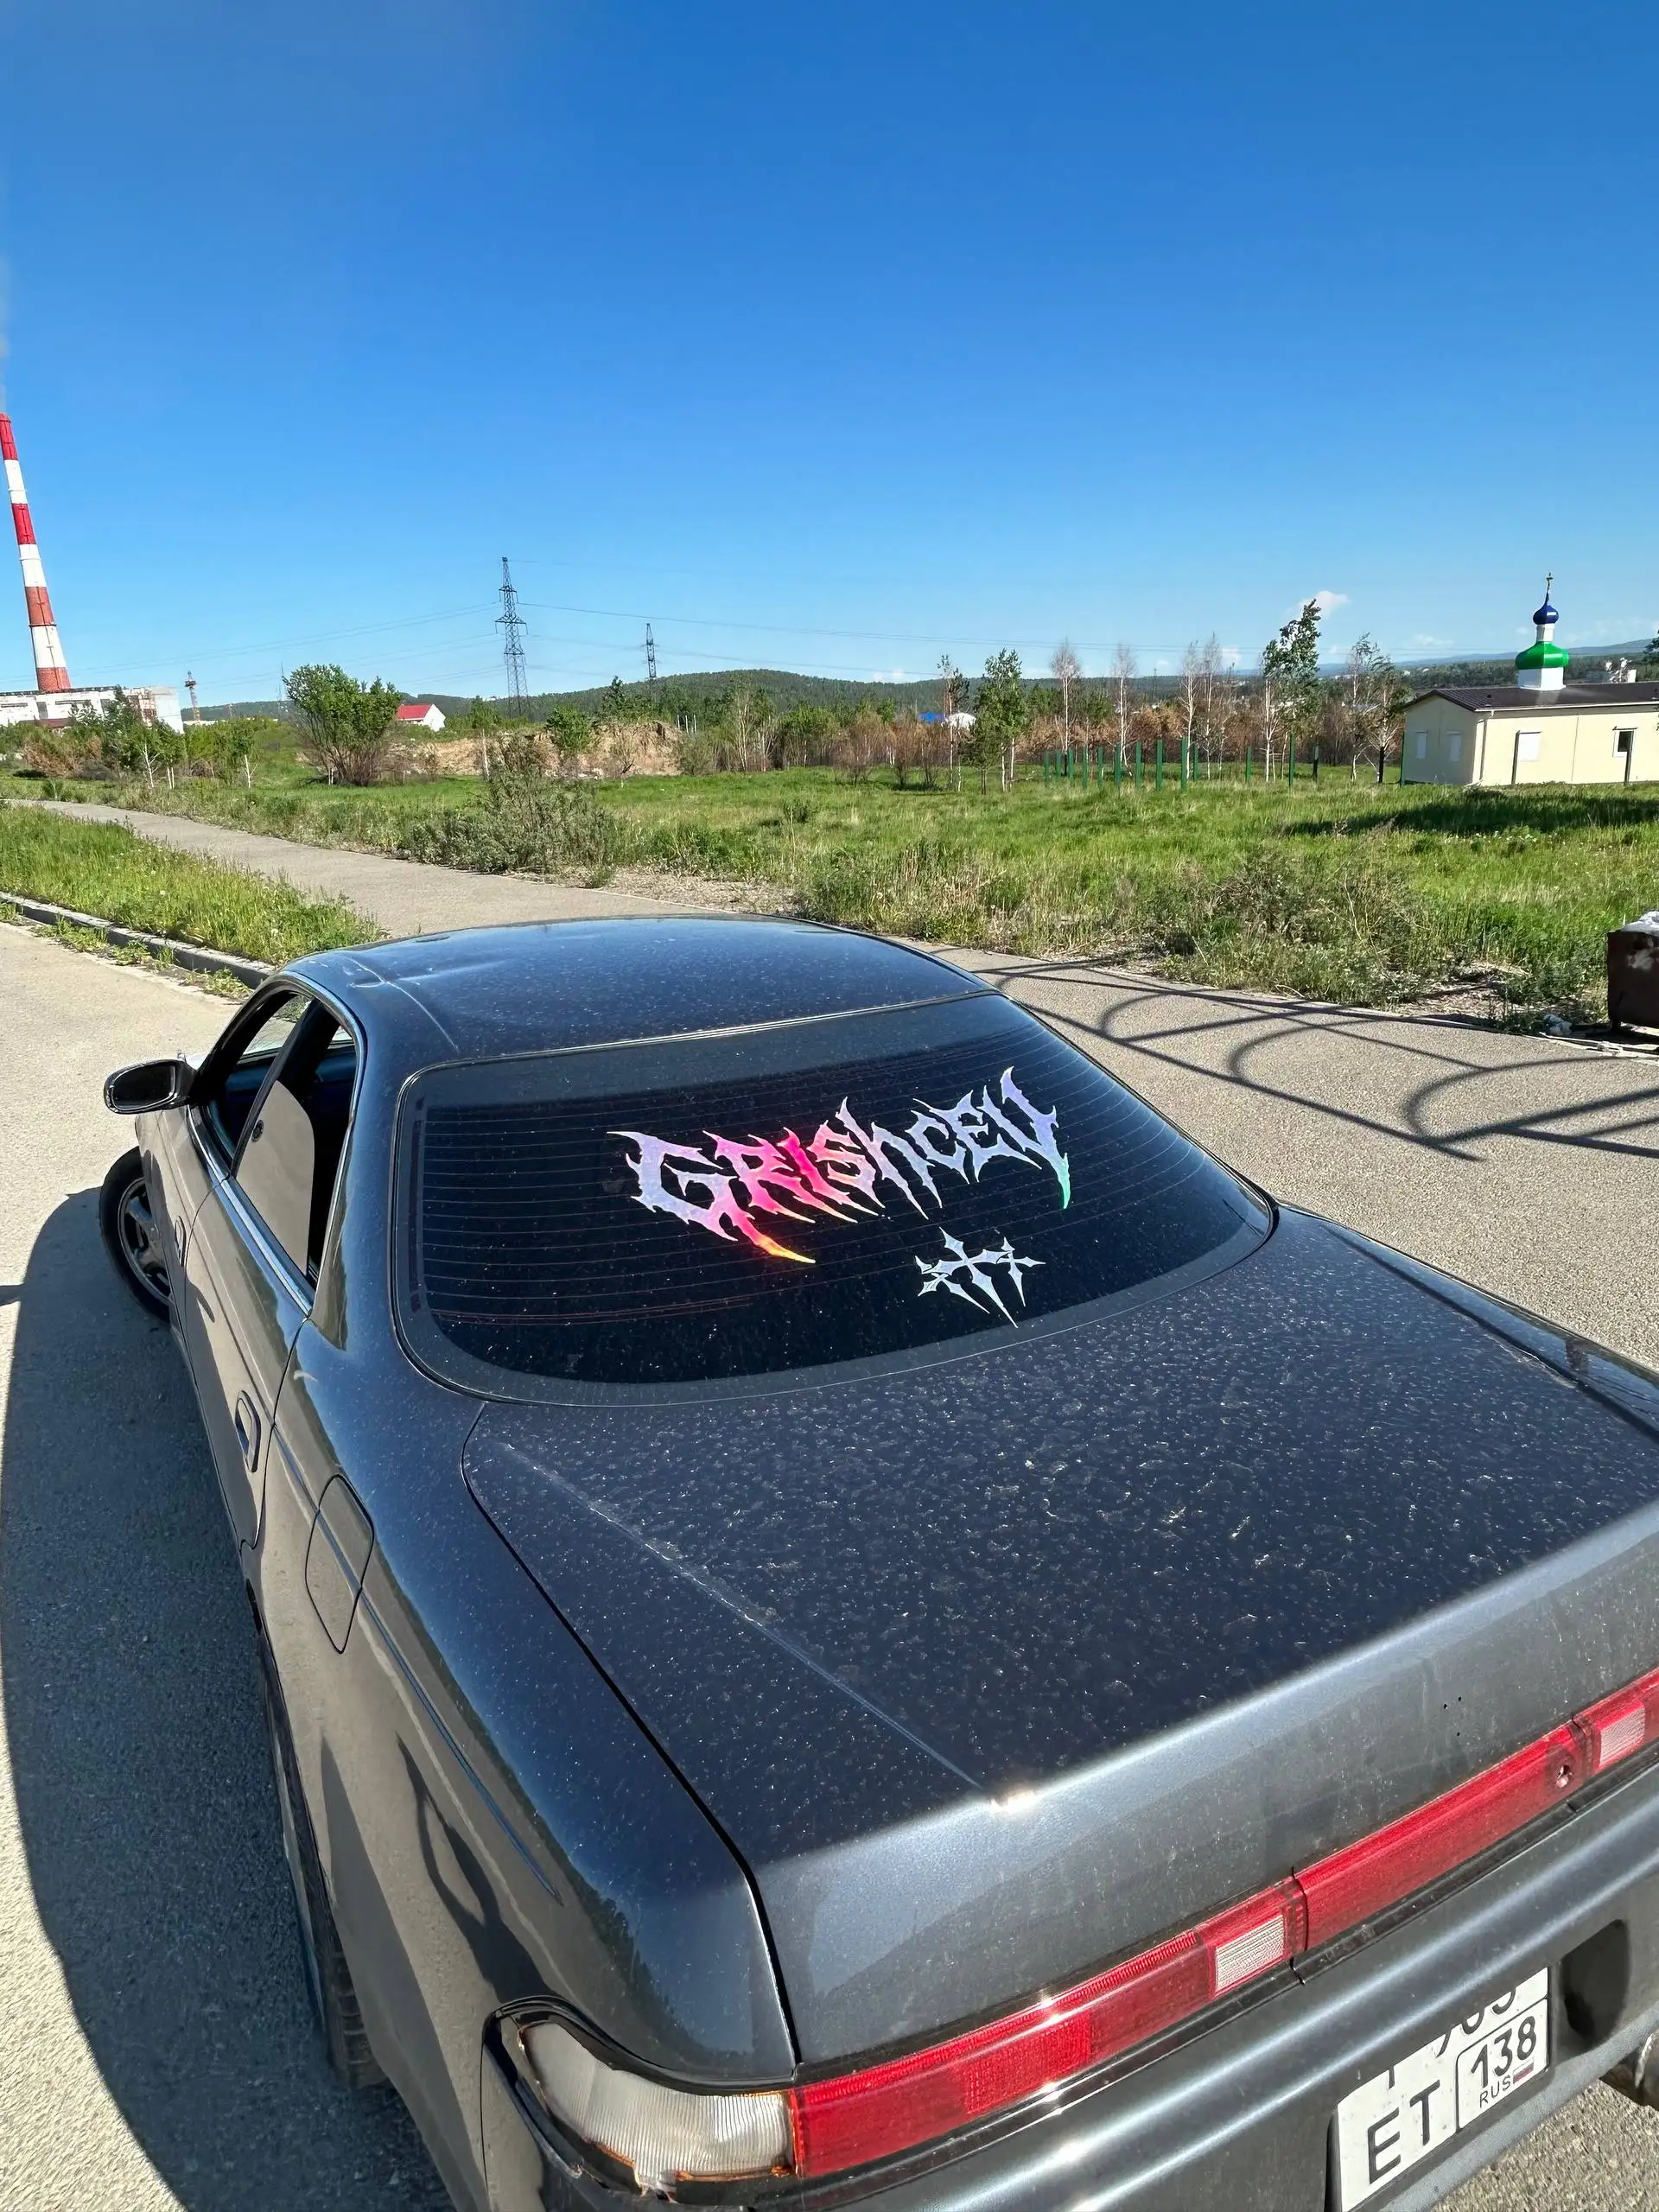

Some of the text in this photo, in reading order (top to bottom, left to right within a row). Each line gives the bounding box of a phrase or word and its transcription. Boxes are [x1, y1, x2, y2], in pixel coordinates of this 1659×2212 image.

[1470, 2015, 1537, 2088] 138
[1479, 2075, 1511, 2108] RUS
[1367, 2079, 1441, 2185] ET
